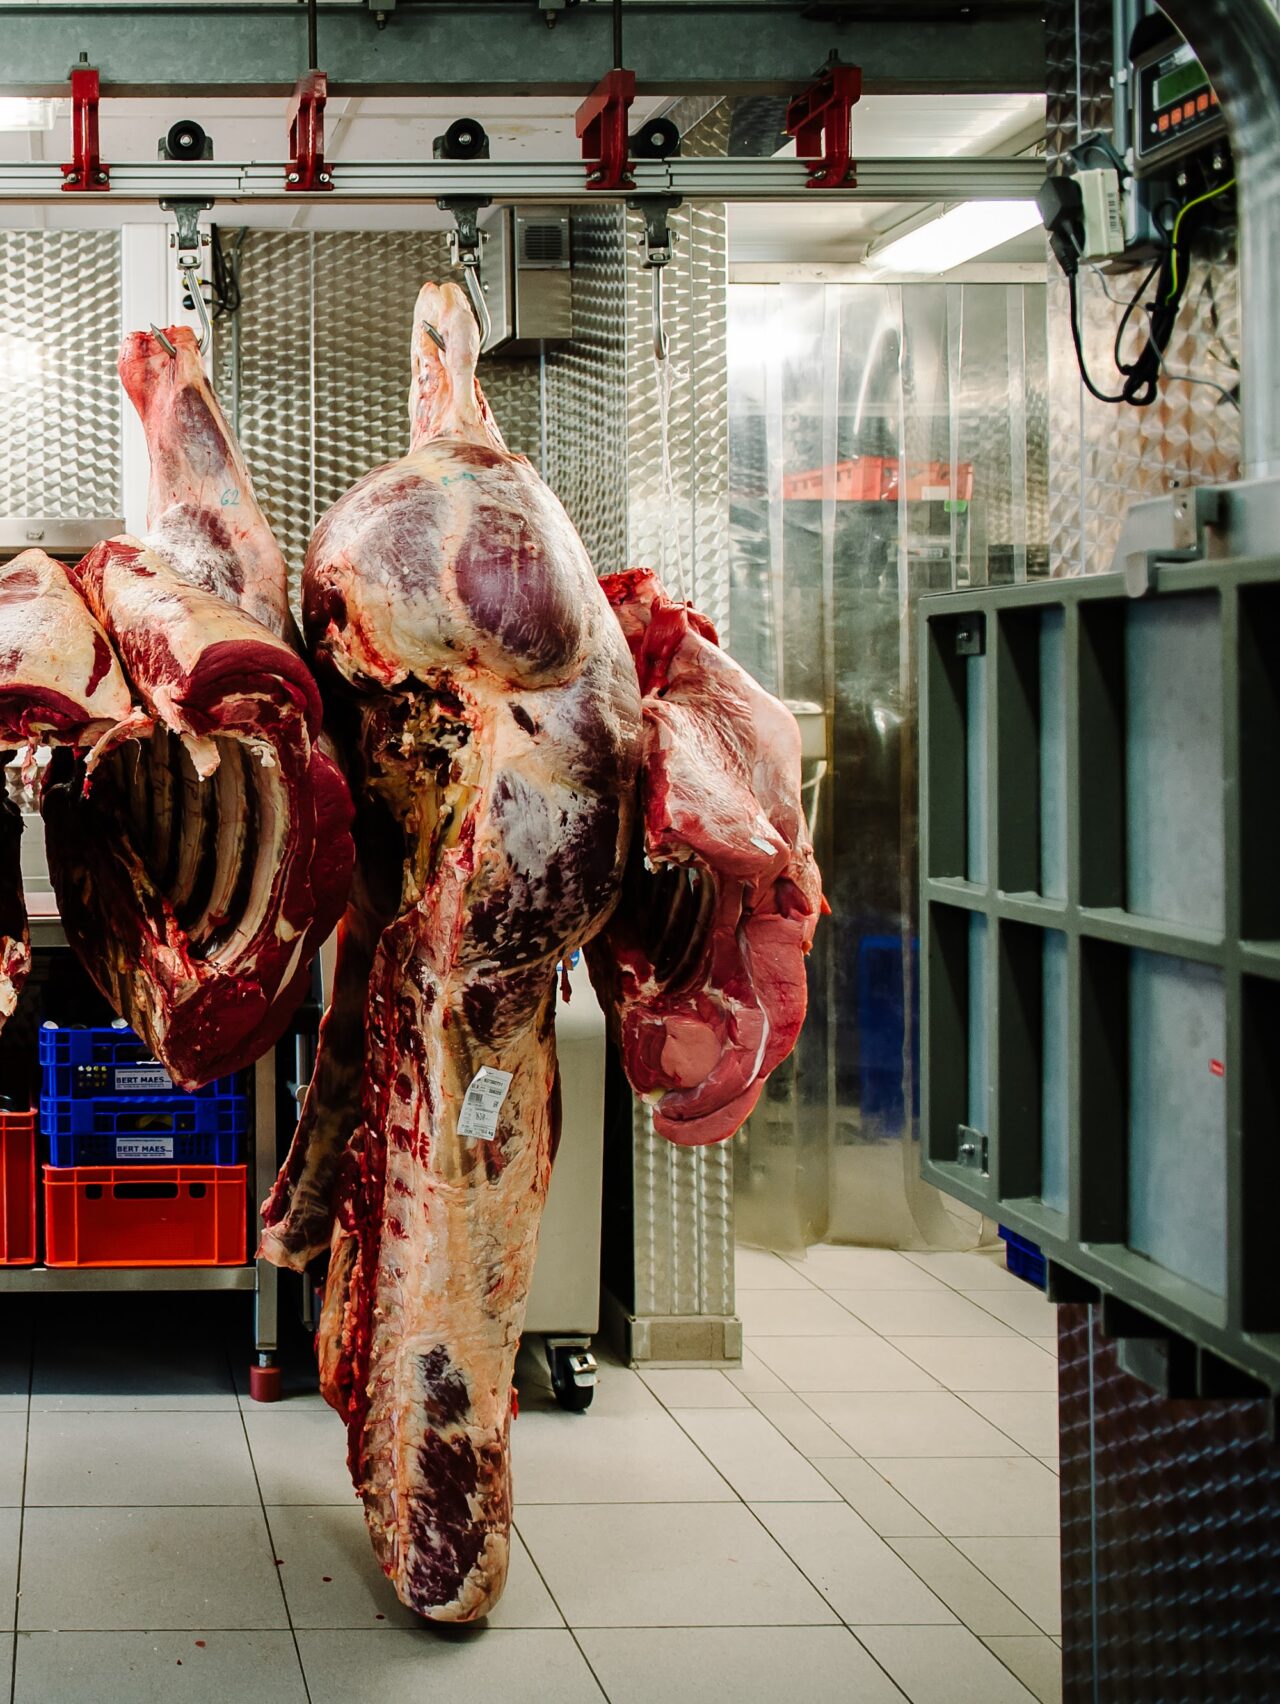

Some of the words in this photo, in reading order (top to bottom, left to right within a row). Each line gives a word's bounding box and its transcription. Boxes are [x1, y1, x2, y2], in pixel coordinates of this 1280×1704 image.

[116, 1076, 138, 1084] BERT
[140, 1076, 165, 1084] MAES
[117, 1145, 139, 1153] BERT
[142, 1145, 166, 1153] MAES
